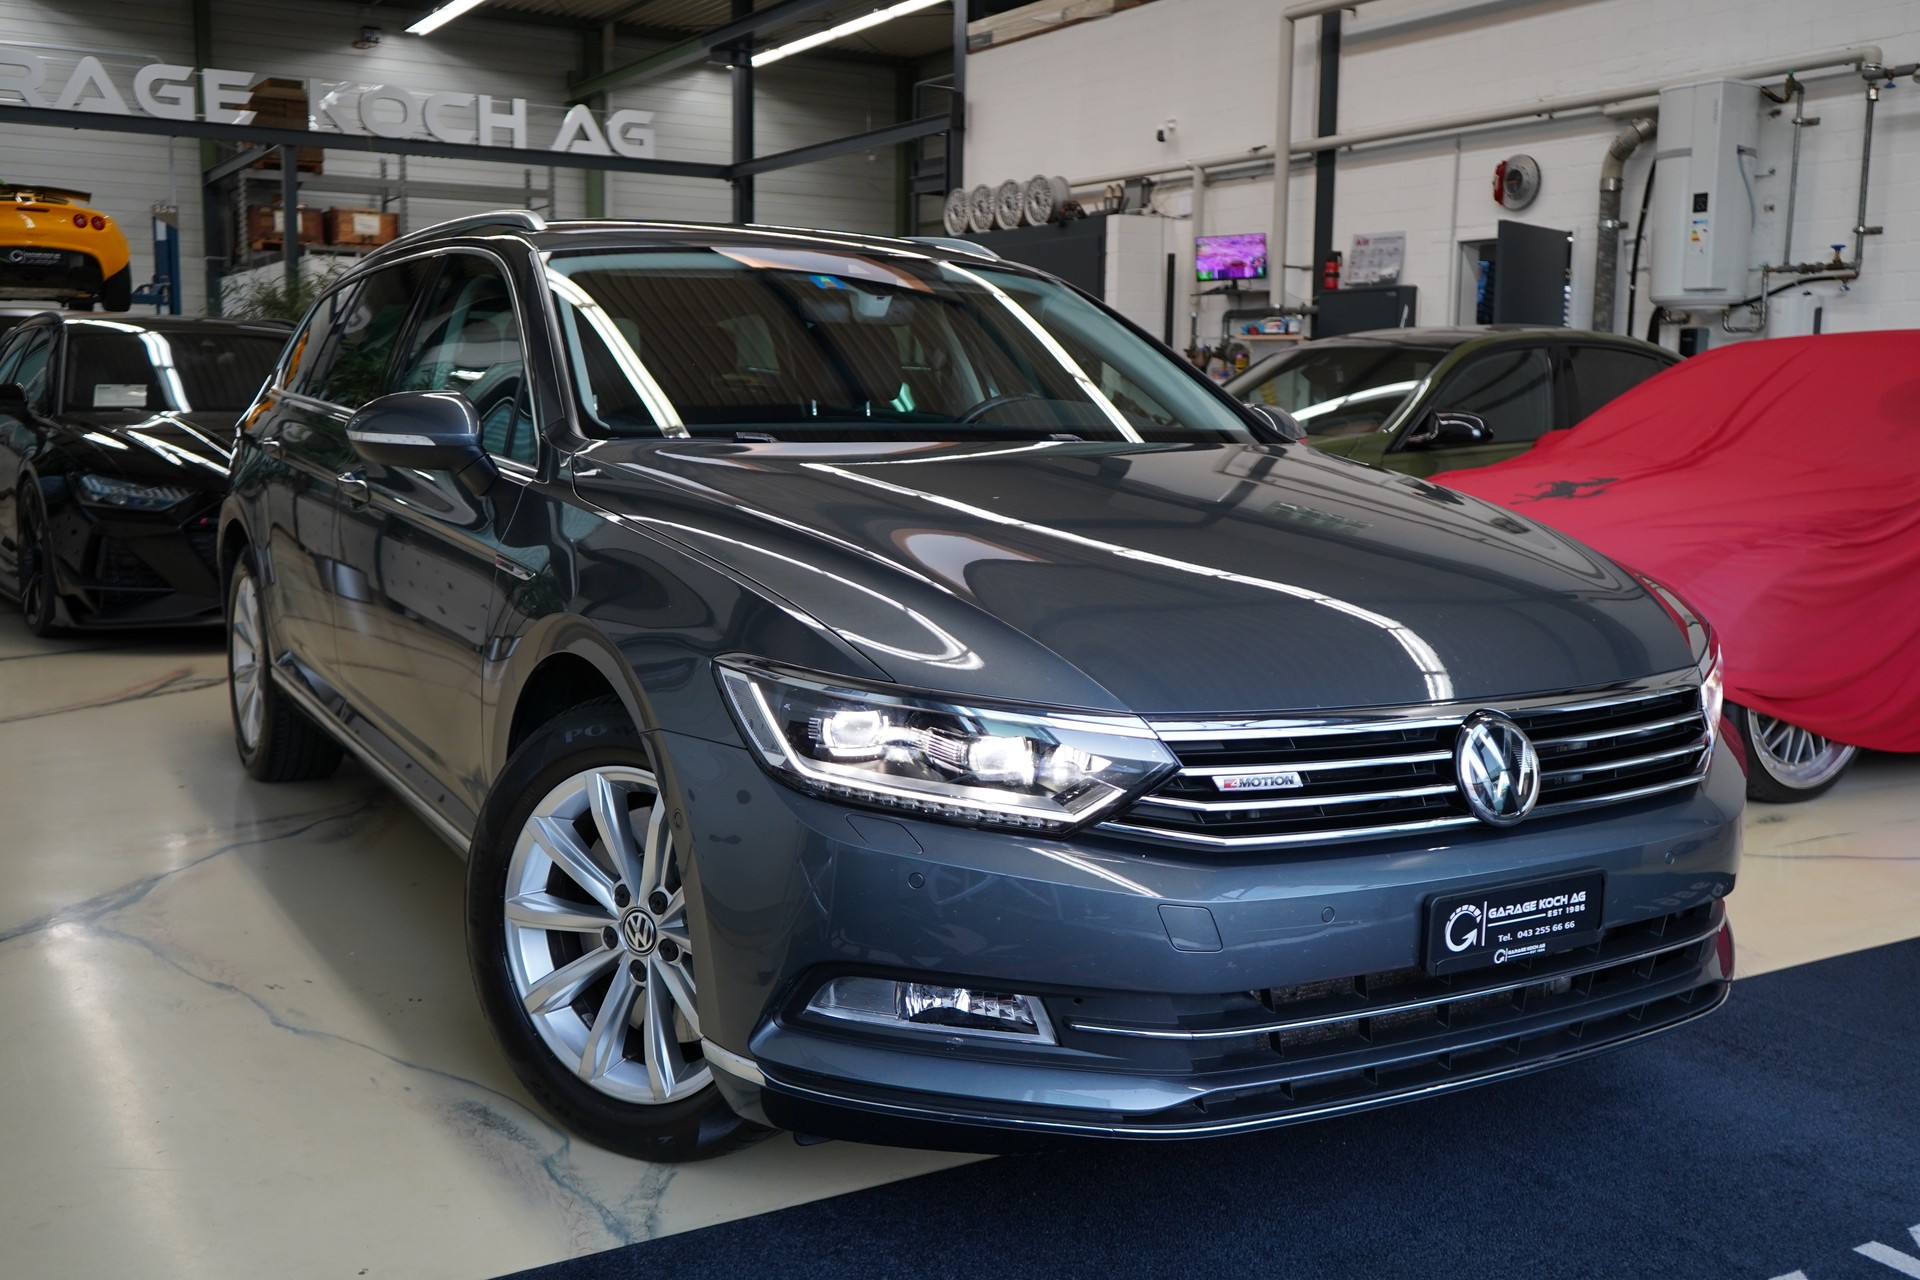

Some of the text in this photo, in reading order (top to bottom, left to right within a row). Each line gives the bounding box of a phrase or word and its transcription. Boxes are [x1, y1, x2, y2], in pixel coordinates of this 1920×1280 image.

[308, 78, 527, 149] KOCH
[551, 104, 655, 159] AG
[1488, 890, 1586, 919] GARAGE KOCH AG
[1547, 904, 1586, 918] EST 1986
[1498, 920, 1575, 943] Tel. 043 255 66 66
